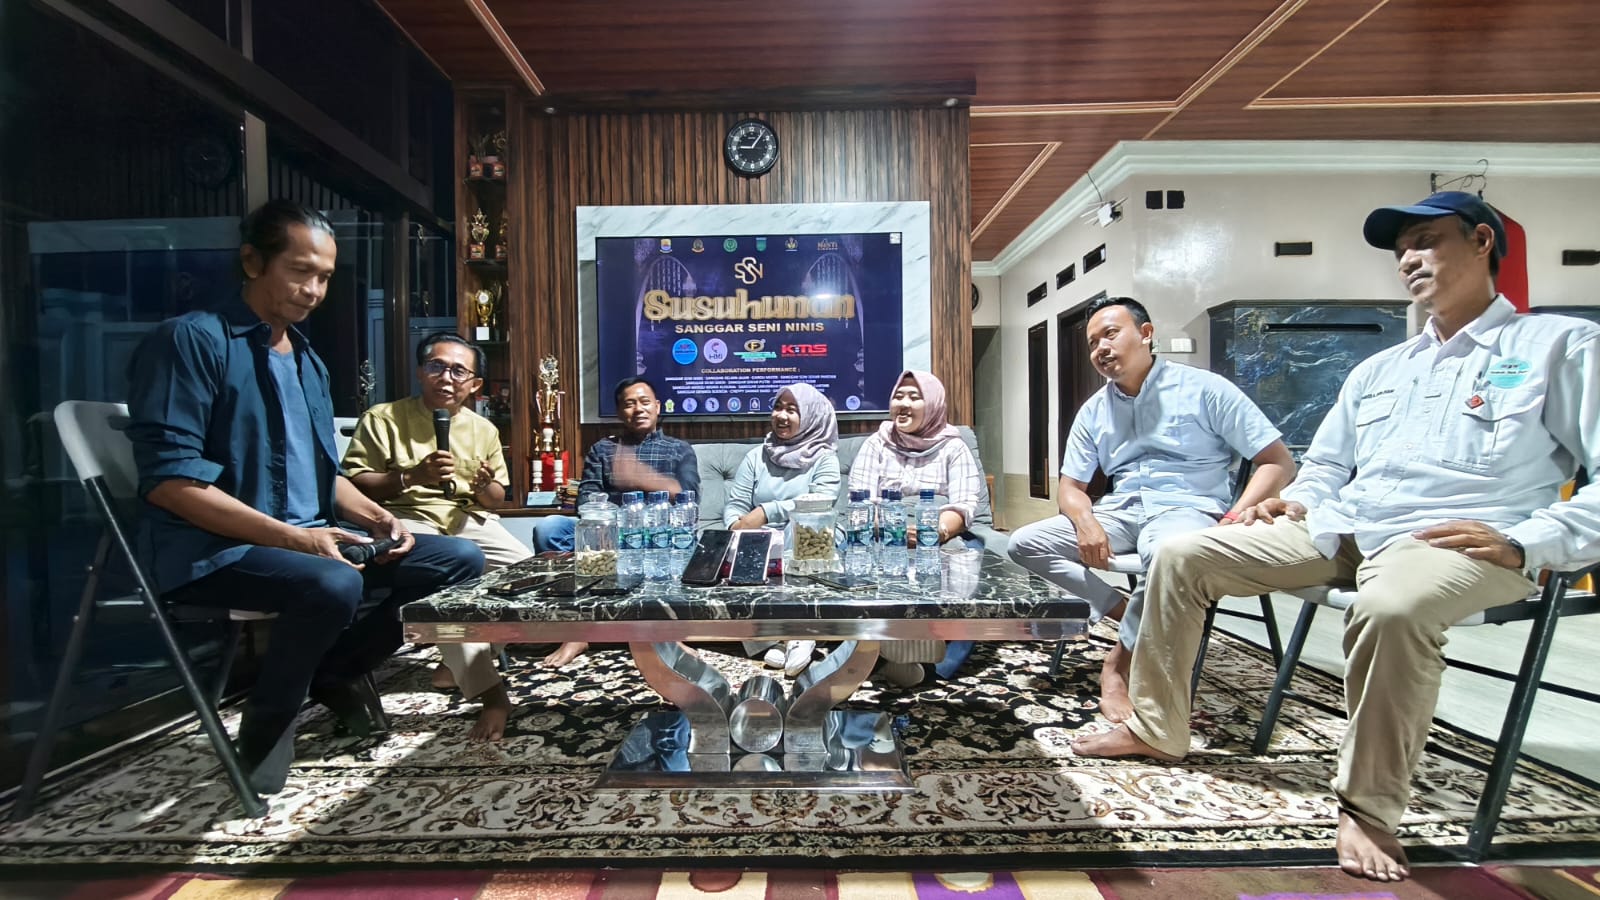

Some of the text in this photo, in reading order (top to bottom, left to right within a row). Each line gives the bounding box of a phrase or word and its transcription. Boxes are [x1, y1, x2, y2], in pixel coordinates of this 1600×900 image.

[643, 288, 855, 321] Susuhunan
[675, 322, 825, 334] SANGGAR SENI NINIS
